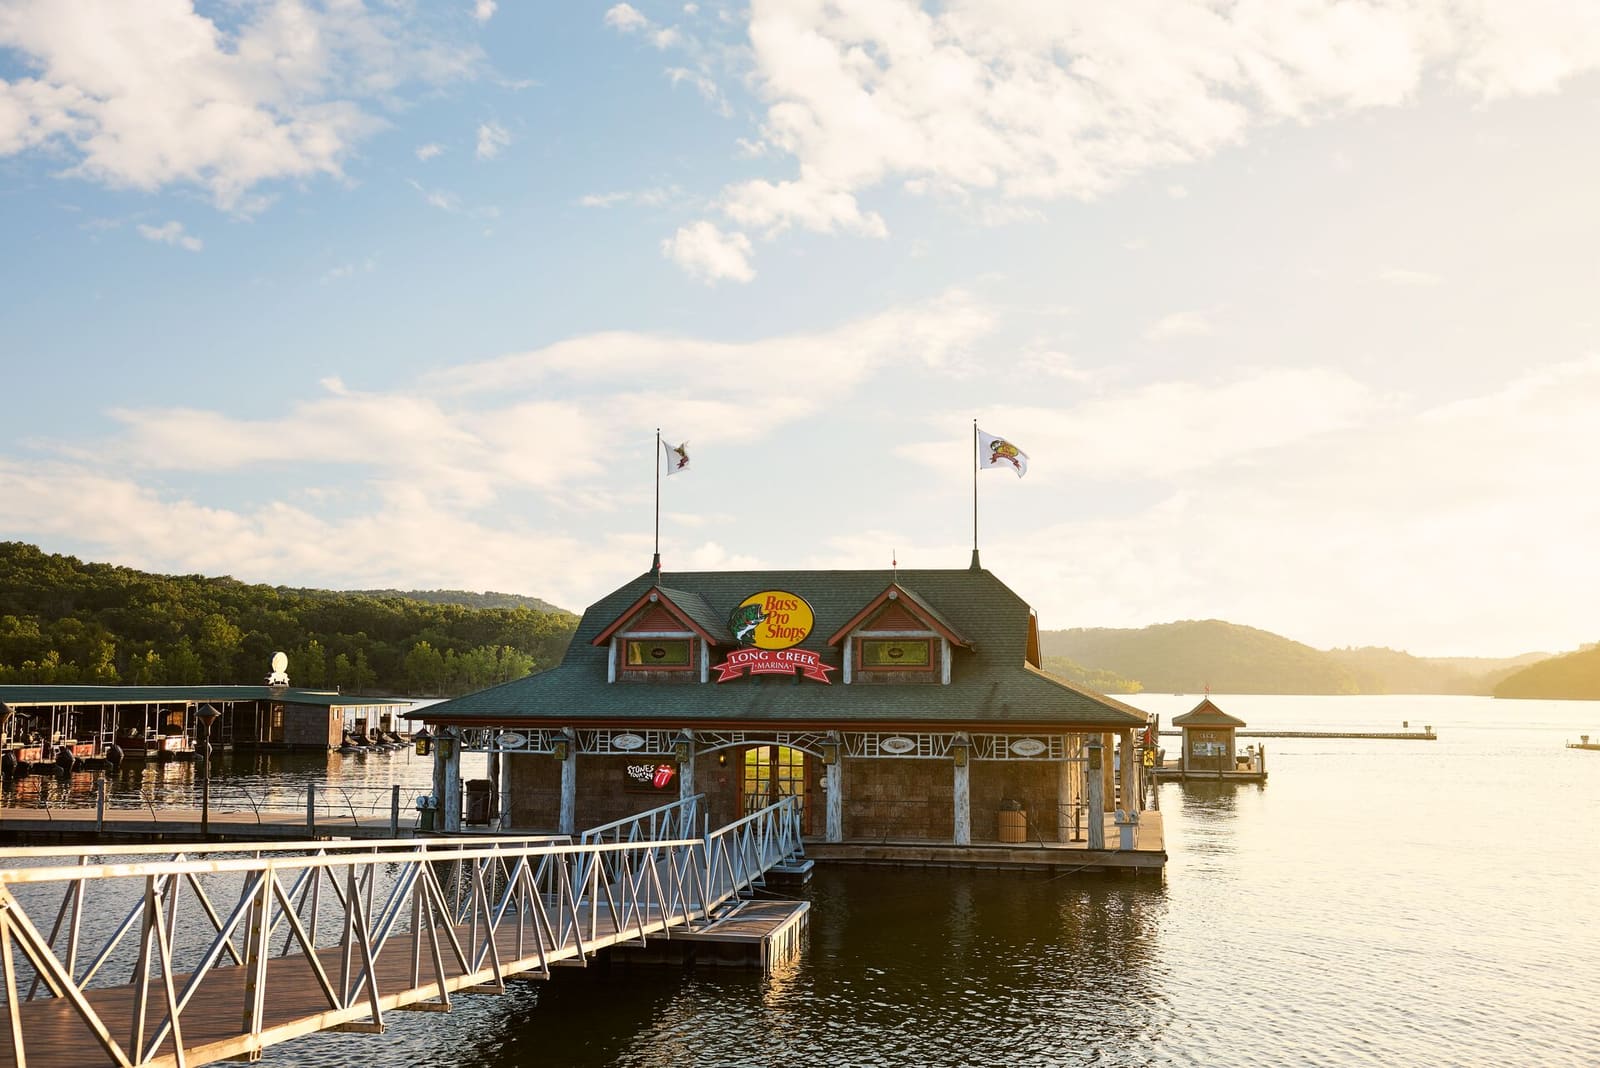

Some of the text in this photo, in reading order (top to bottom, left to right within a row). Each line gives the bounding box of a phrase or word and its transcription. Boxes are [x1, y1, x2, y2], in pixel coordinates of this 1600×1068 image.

[765, 596, 798, 611] Bass
[766, 611, 790, 625] Pro
[766, 624, 806, 642] Shops
[731, 651, 816, 665] LONG CREEK
[627, 764, 655, 775] STONES
